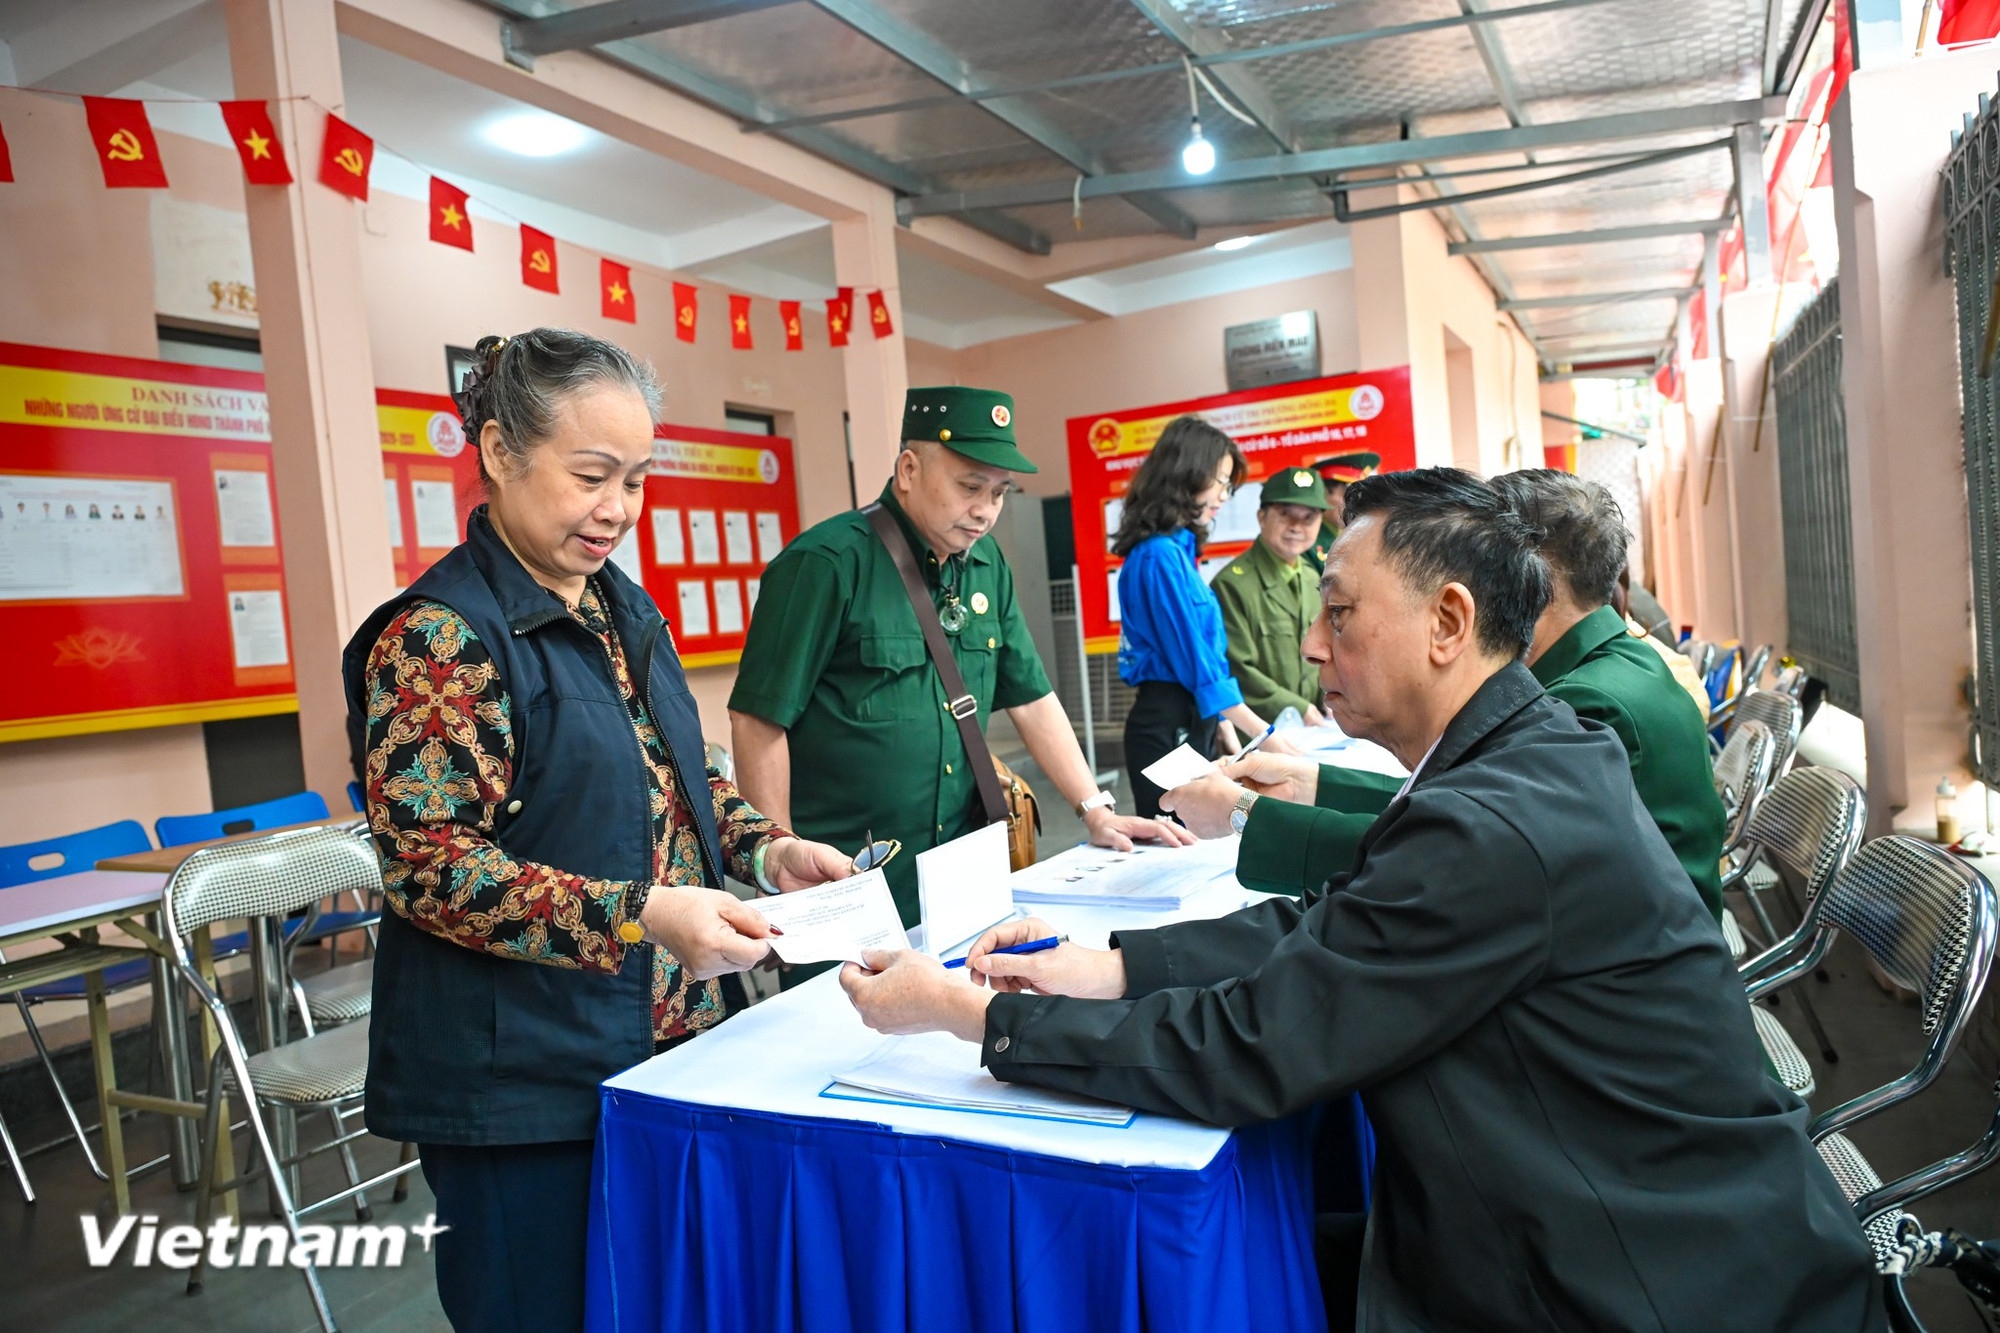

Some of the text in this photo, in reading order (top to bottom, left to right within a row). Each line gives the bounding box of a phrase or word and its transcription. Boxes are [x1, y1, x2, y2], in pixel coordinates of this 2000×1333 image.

[24, 397, 64, 417] NHỮNG
[132, 386, 187, 406] DANH
[192, 391, 242, 411] SÁCH
